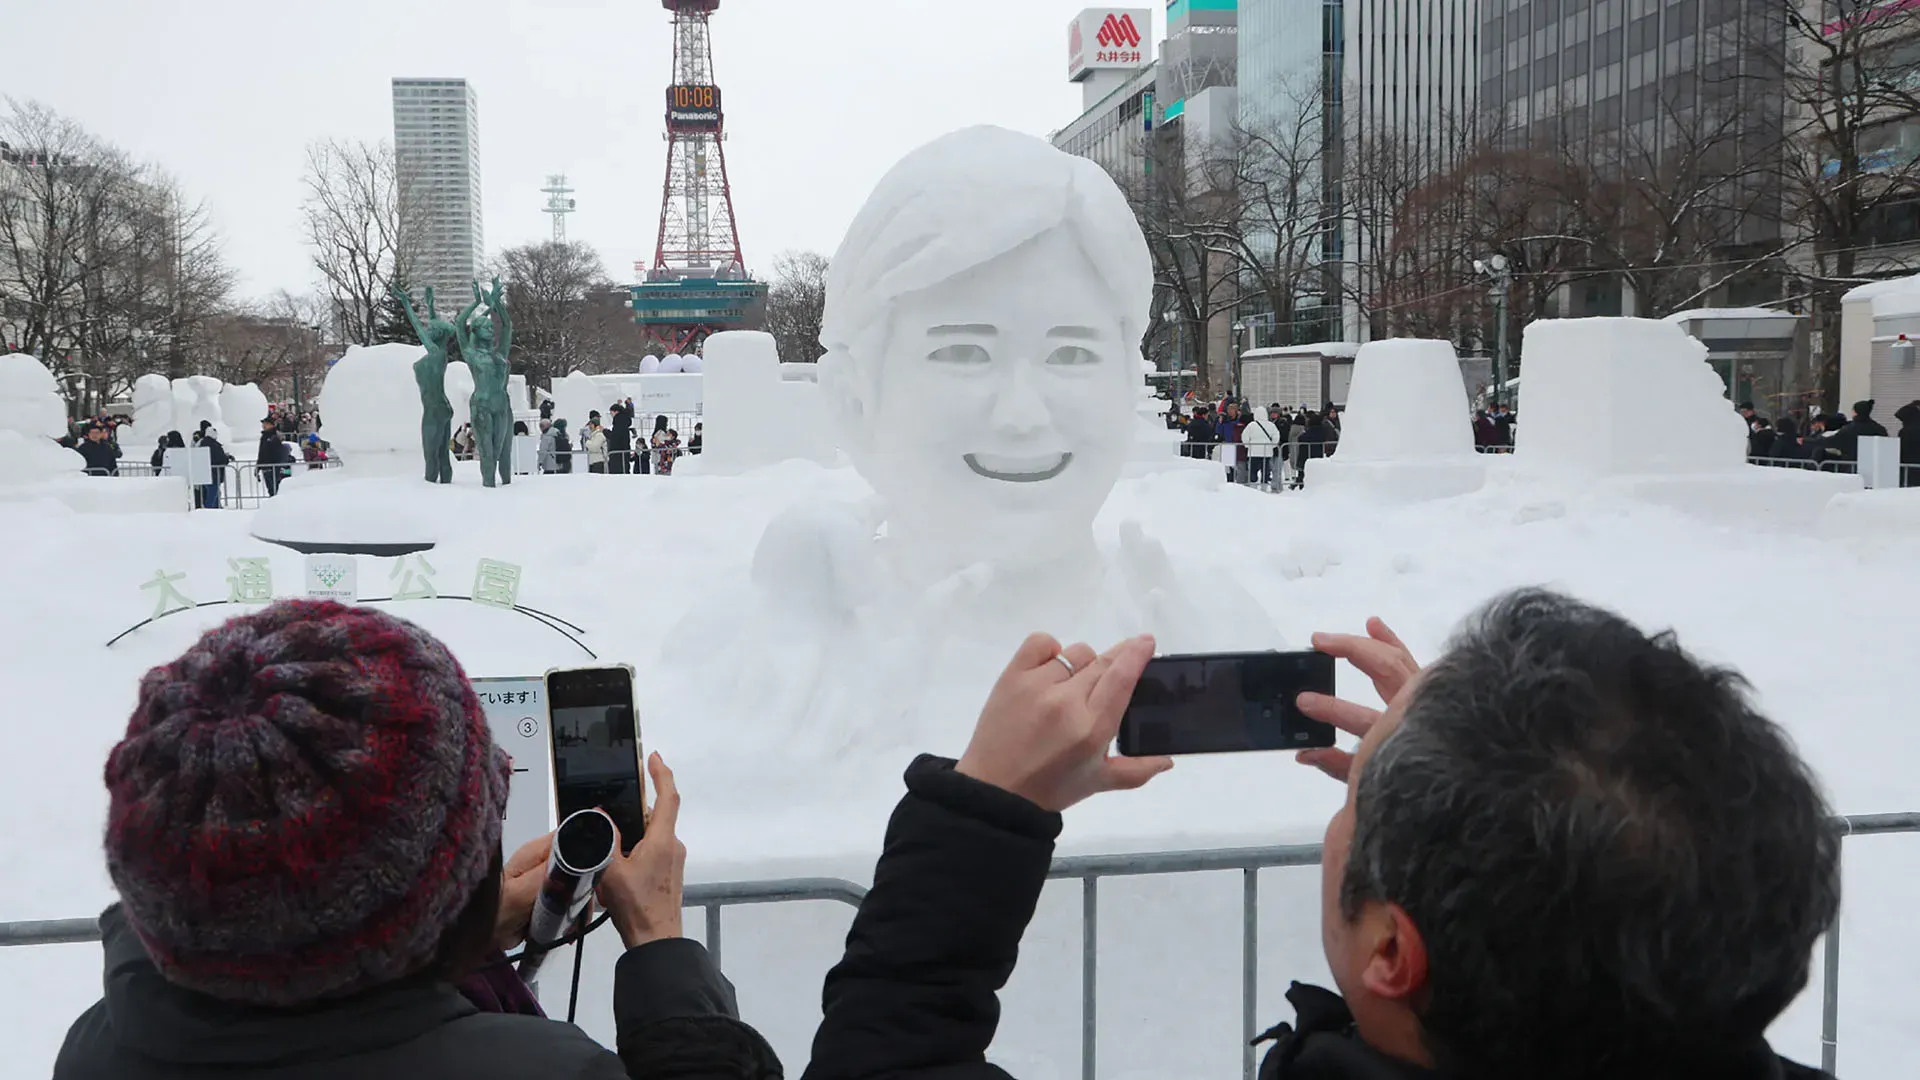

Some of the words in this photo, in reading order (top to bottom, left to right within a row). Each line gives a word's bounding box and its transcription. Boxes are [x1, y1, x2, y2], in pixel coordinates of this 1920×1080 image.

[1096, 51, 1141, 62] 丸井今井
[674, 86, 713, 107] 10:08
[671, 111, 718, 120] Panasonic
